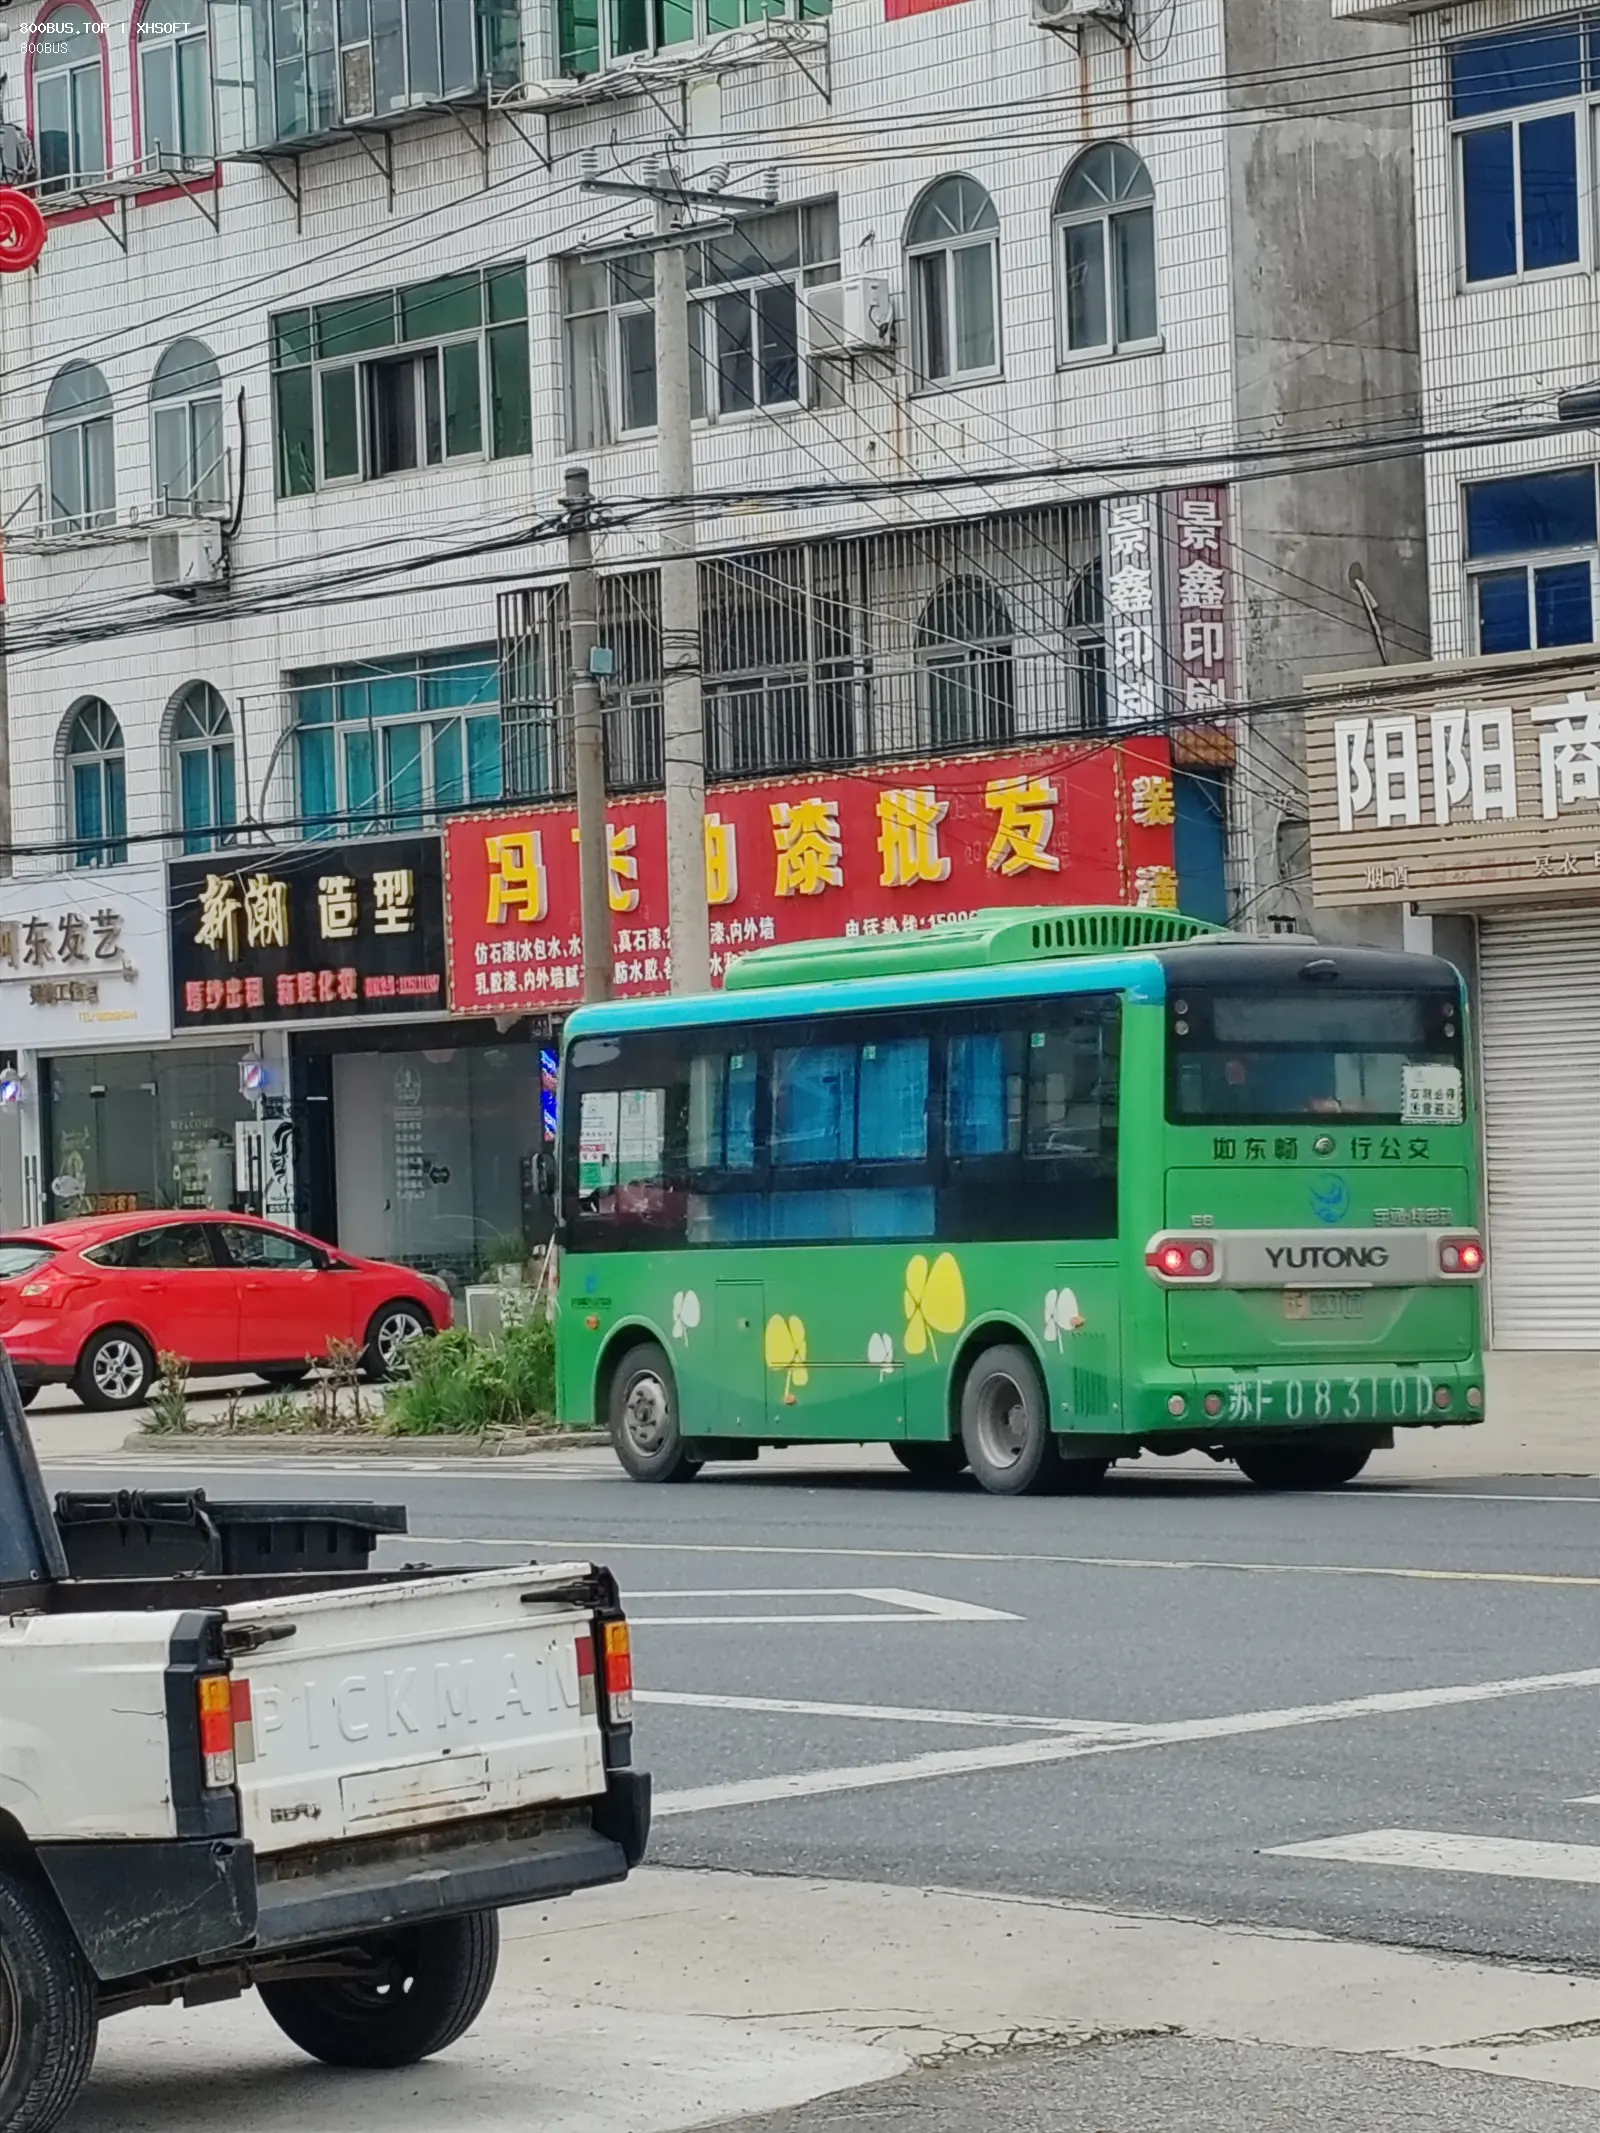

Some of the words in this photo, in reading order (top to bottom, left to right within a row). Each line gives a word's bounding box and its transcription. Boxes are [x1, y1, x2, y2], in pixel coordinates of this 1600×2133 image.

[1107, 503, 1154, 727] 景鑫印刷
[1177, 500, 1225, 727] 景鑫印刷
[194, 872, 290, 963] 新潮
[318, 869, 417, 941] 造型
[1364, 864, 1410, 890] 烟酒
[1532, 850, 1600, 877] 冥衣
[1350, 1137, 1430, 1160] 行公交
[1265, 1246, 1390, 1269] YUTONG
[252, 1642, 581, 1757] PICKMAN
